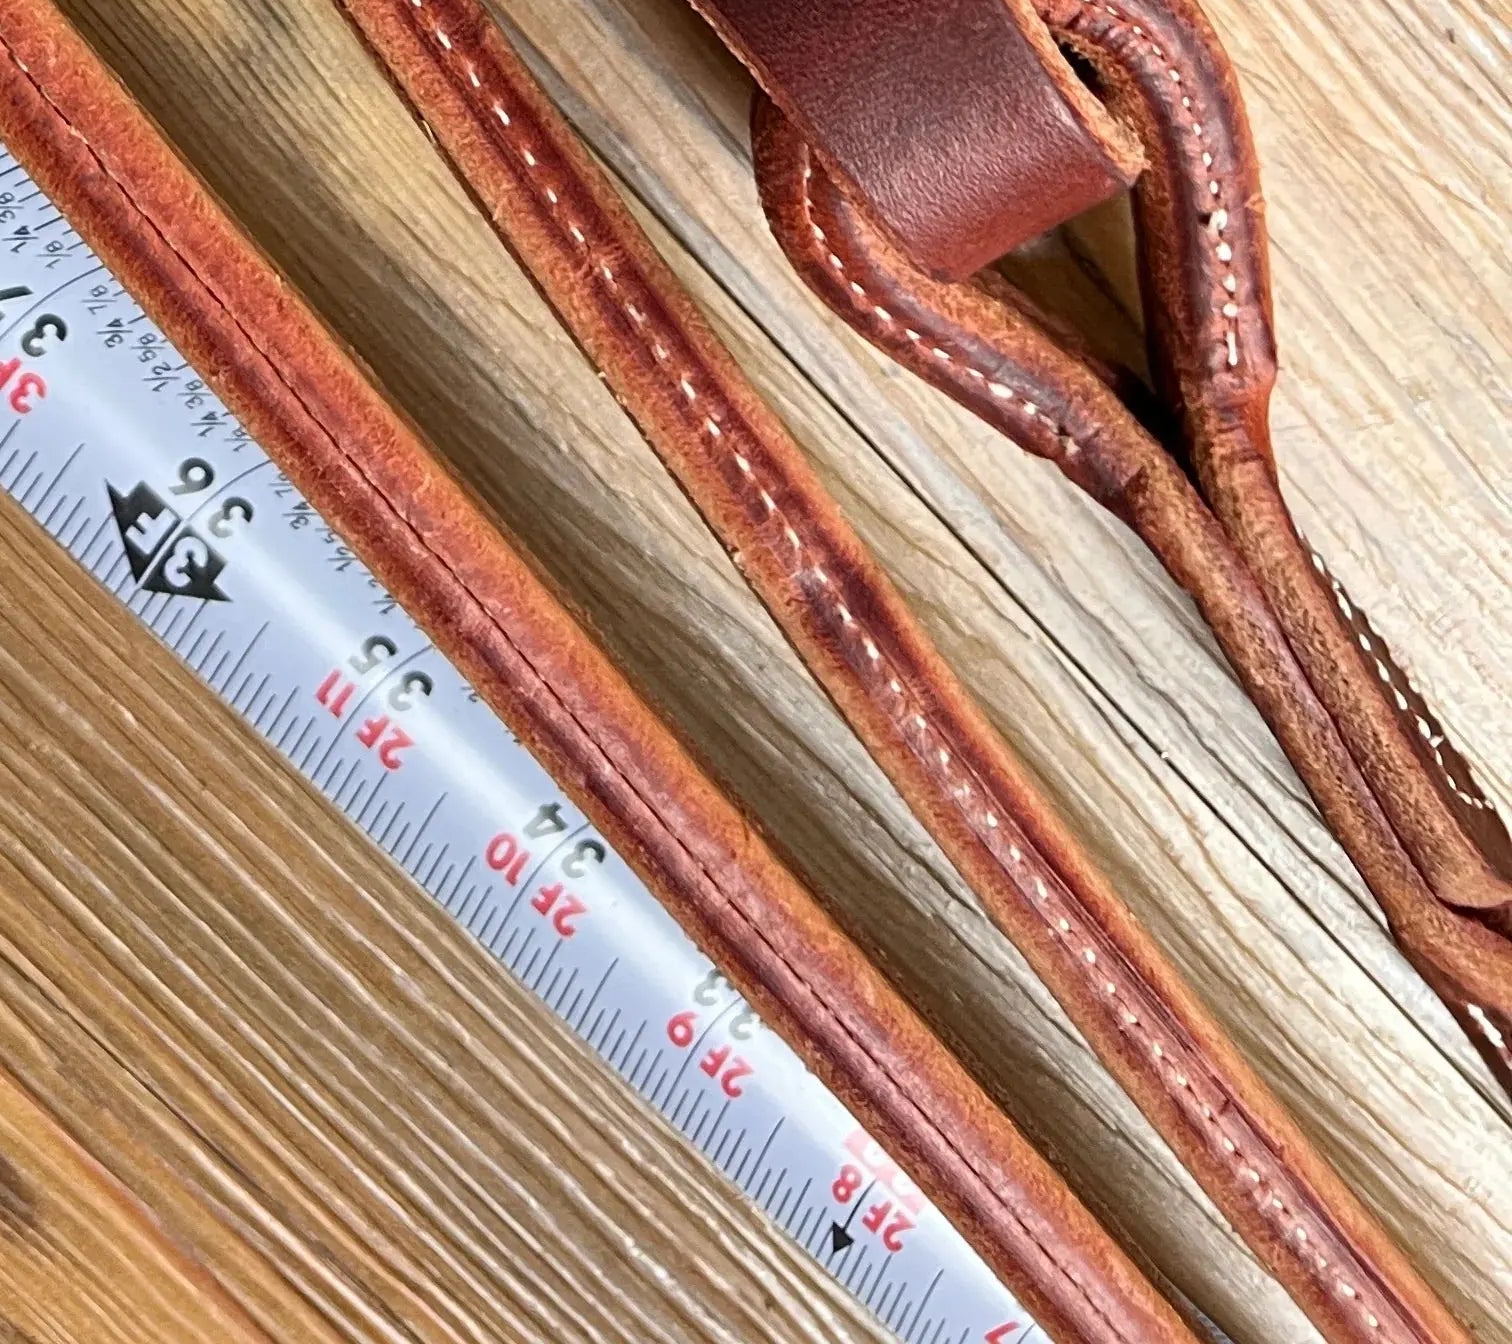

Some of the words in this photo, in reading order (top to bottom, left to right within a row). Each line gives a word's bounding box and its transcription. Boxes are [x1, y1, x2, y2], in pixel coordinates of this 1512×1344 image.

[3, 225, 38, 253] 1/4
[38, 241, 70, 268] 1/8
[81, 285, 117, 315] 7/8
[97, 318, 132, 348] 3/4
[130, 332, 166, 363] 5/8
[144, 362, 178, 392] 1/2
[192, 412, 225, 437] 1/4
[169, 456, 255, 539] 36
[126, 509, 209, 589] 3F
[348, 635, 434, 712] 35
[315, 669, 356, 719] 11
[522, 801, 606, 878] 34
[485, 832, 530, 887] 10
[666, 1011, 698, 1048] 9
[832, 1164, 863, 1204] 8
